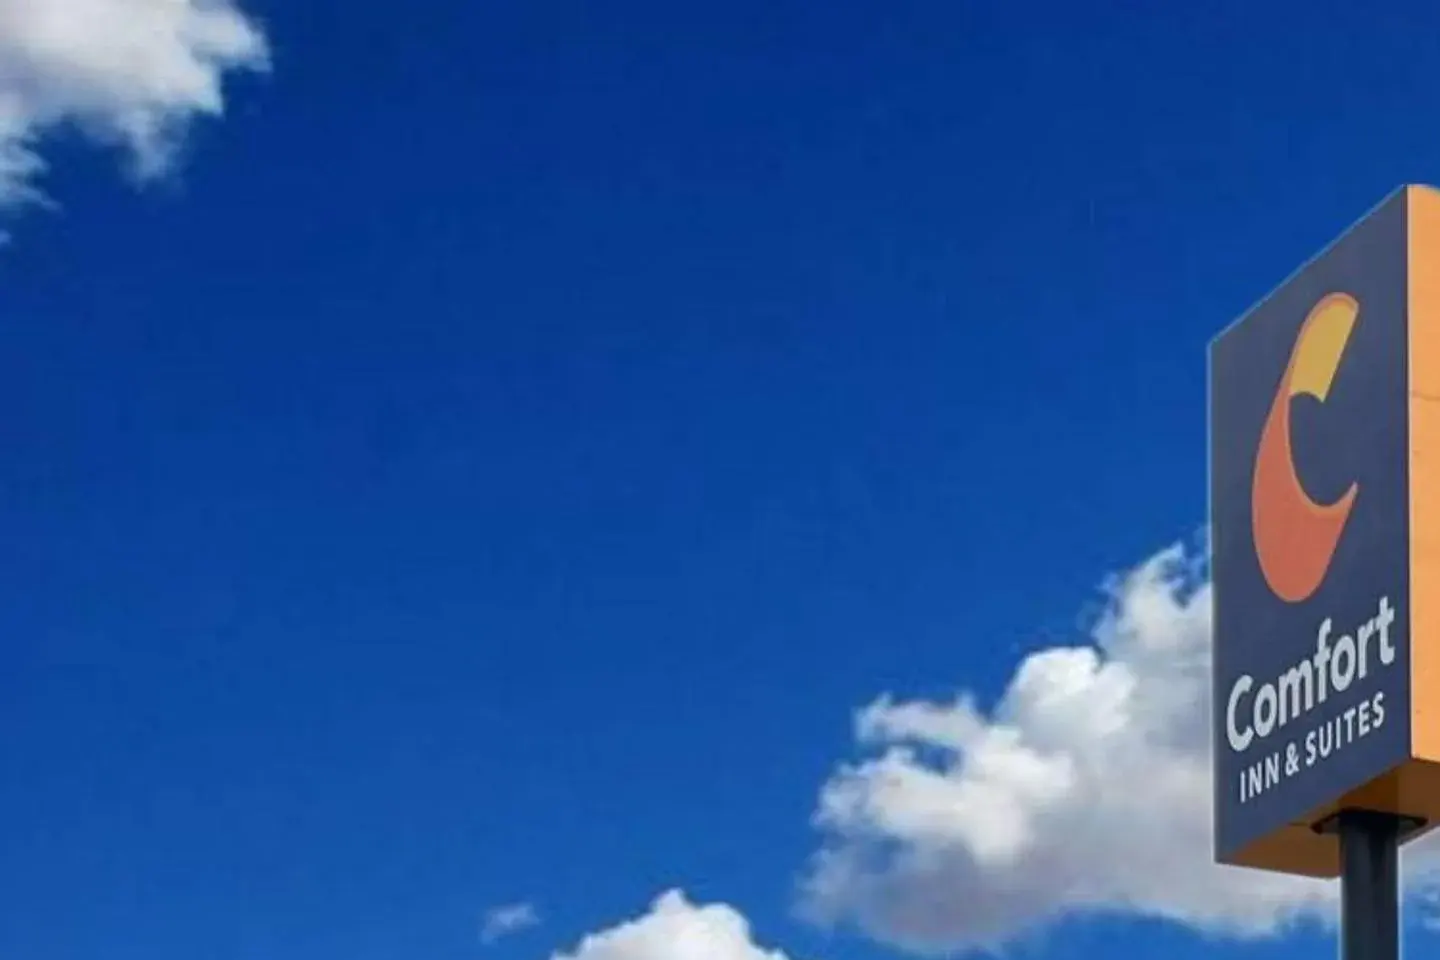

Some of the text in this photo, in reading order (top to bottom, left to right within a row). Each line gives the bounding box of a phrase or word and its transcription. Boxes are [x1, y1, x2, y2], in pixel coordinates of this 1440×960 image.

[1226, 596, 1395, 752] Comfort
[1240, 691, 1385, 803] INN & SUITES
